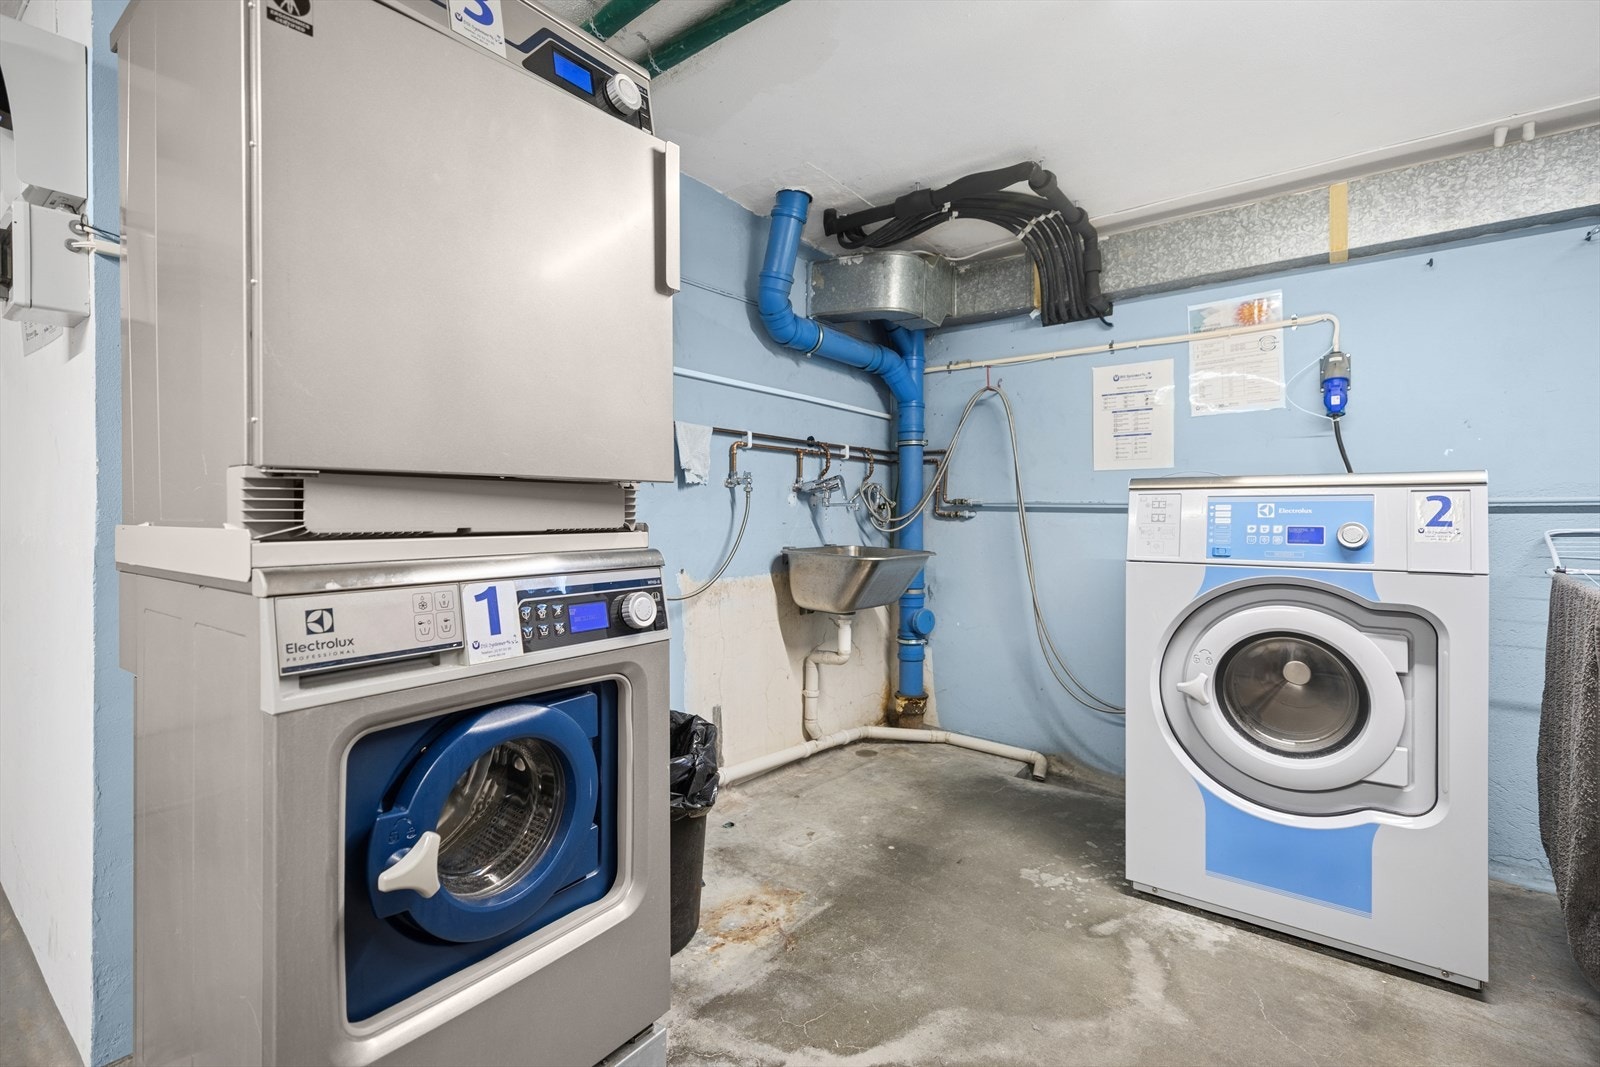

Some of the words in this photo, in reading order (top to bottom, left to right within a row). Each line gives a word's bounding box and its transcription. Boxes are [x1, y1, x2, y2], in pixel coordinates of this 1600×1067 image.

[1425, 495, 1453, 527] 2
[474, 585, 502, 636] 1
[285, 637, 355, 655] Electrolux
[286, 649, 355, 662] PROFESSIONAL
